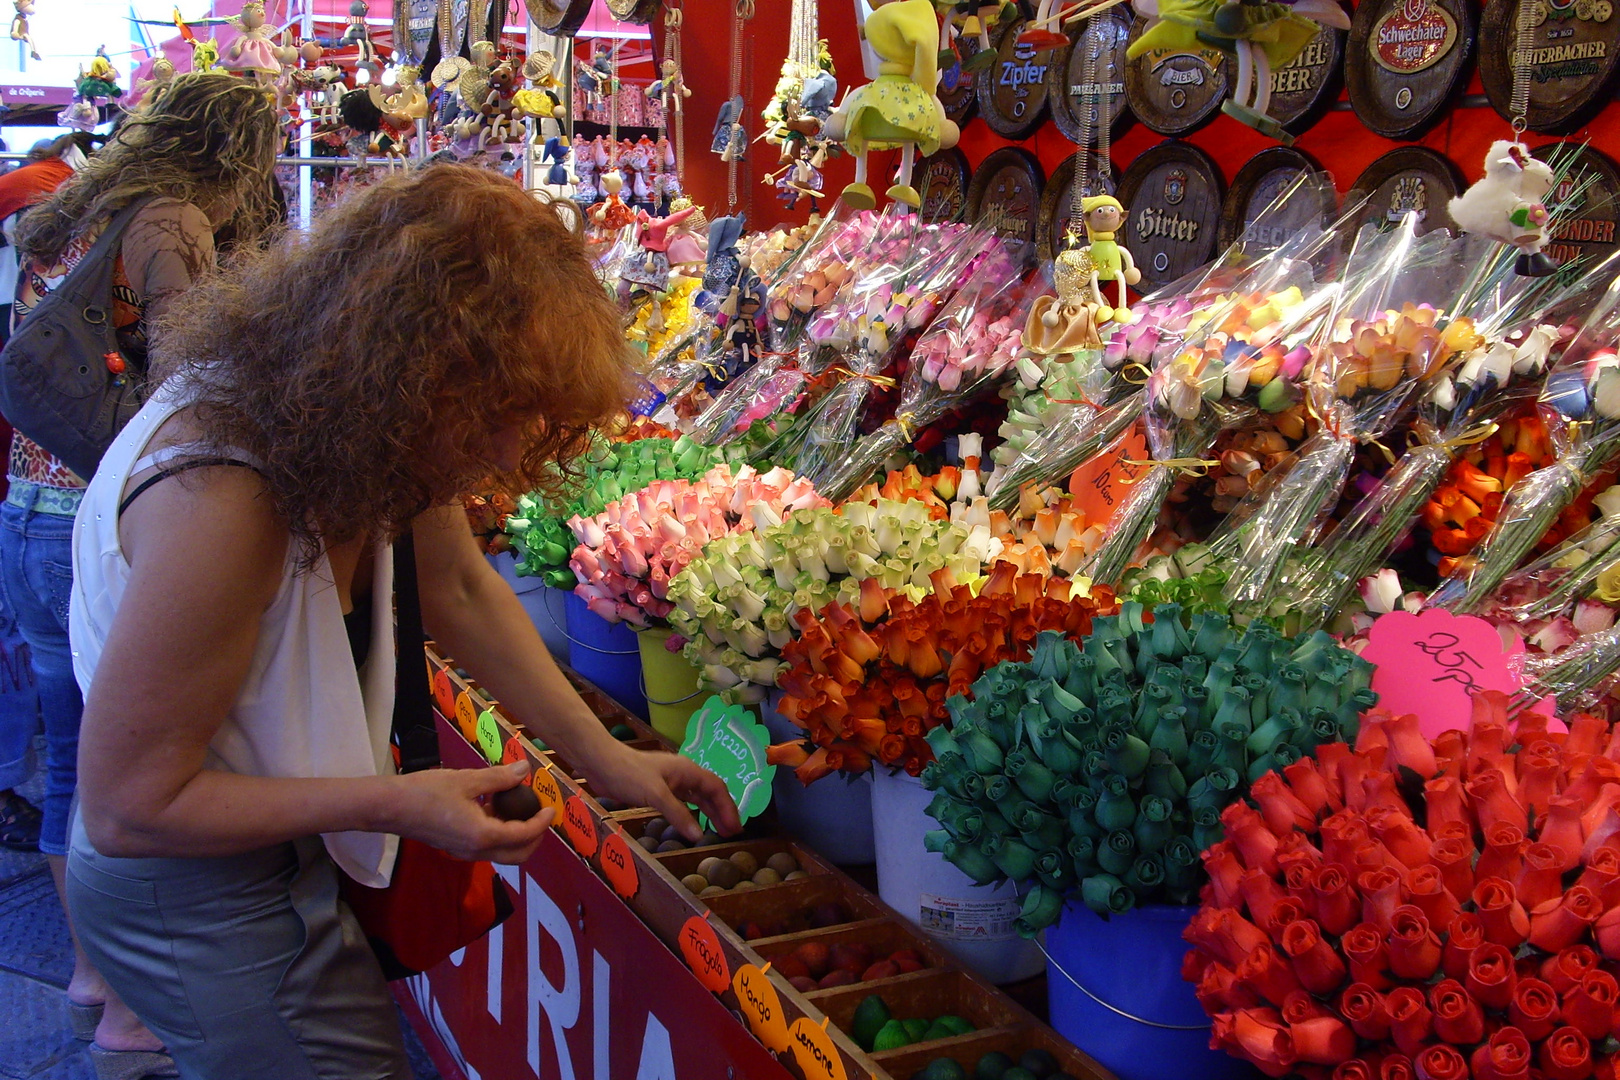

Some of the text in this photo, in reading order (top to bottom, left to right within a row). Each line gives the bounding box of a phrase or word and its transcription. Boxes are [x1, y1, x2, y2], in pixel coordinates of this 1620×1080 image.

[1378, 24, 1447, 44] Schwechater
[1397, 44, 1424, 61] Lager
[1000, 61, 1047, 90] Zipfer
[1171, 71, 1192, 82] BIER
[1270, 69, 1312, 93] BEER
[1136, 207, 1198, 243] Hirter
[1101, 484, 1114, 506] Euro
[688, 927, 723, 978] Fragola
[741, 973, 771, 1023] Mango
